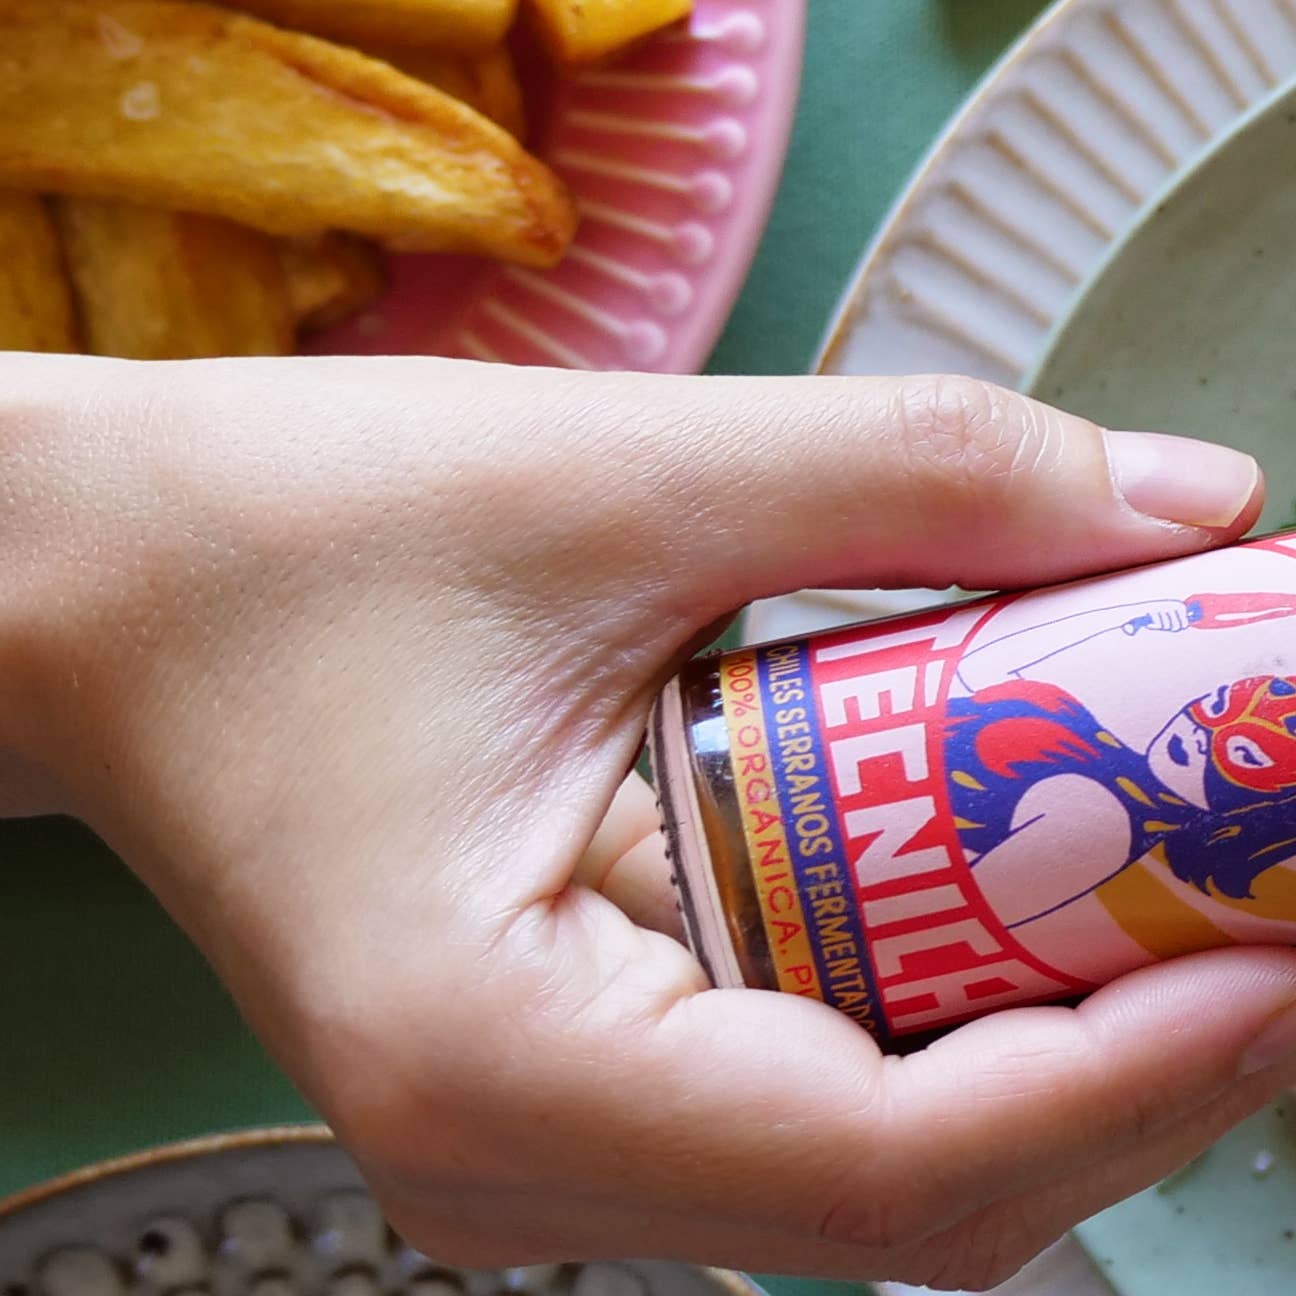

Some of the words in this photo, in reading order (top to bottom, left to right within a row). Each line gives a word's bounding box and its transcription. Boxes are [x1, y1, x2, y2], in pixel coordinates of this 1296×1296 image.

[726, 657, 760, 717] 100%
[765, 644, 805, 705] CHILES
[776, 705, 834, 858] SERRANOS
[815, 604, 1070, 1030] TÉCNICA
[804, 865, 880, 1034] FERMENTAD
